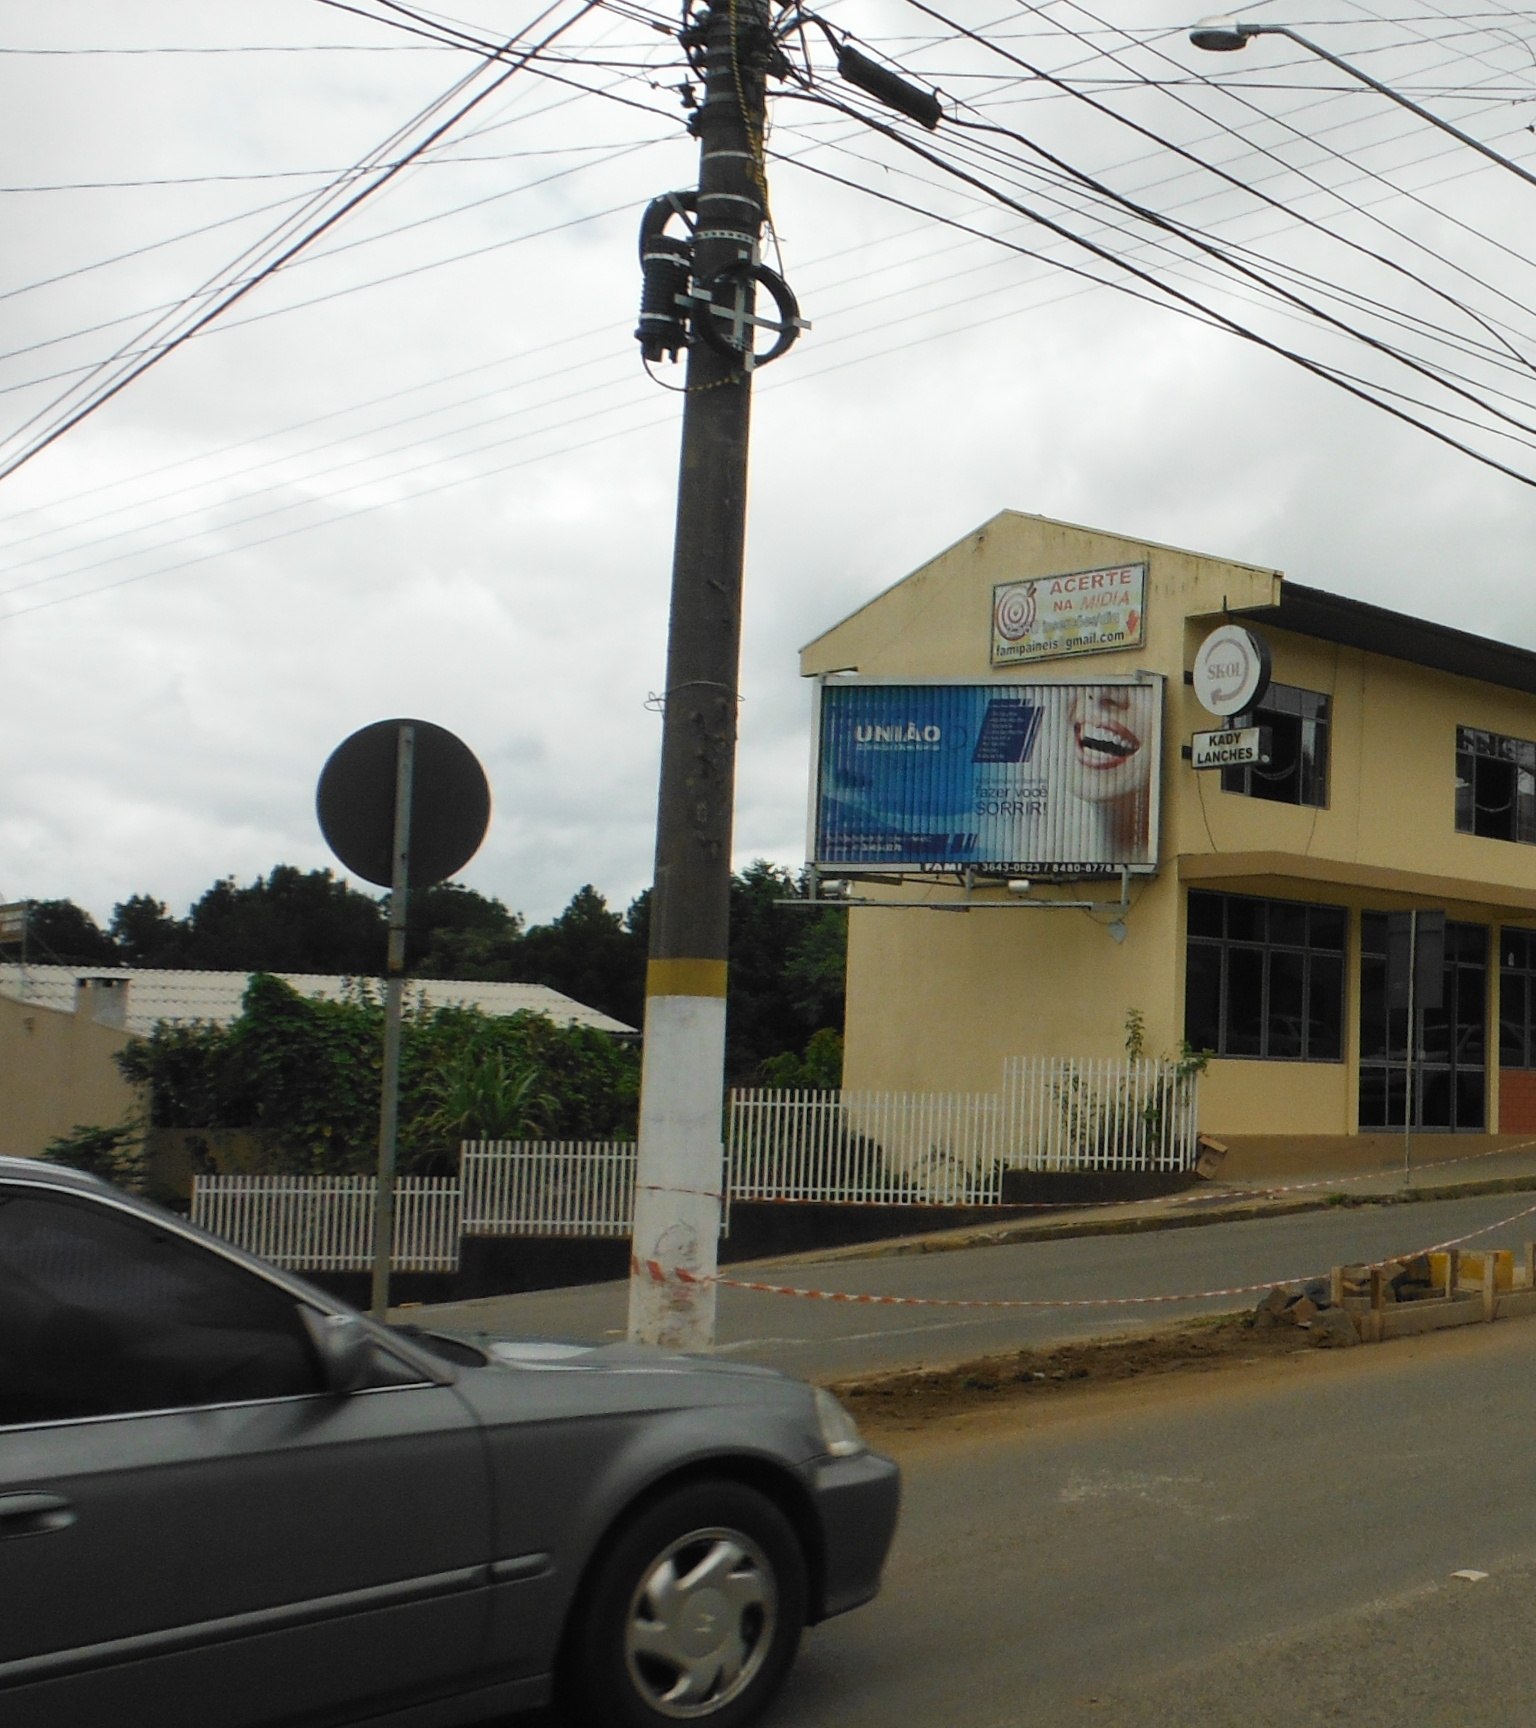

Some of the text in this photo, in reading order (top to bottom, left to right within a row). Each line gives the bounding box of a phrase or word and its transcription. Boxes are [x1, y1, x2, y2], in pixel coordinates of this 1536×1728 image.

[1049, 569, 1132, 595] ACERTE
[1053, 599, 1073, 612] NA
[1207, 662, 1242, 681] SKOL
[856, 721, 941, 742] UNIÃO
[1209, 732, 1242, 747] KADY
[1197, 747, 1253, 764] LANCHES
[975, 785, 1010, 798] fazer
[975, 801, 1048, 816] SORRIR!
[925, 862, 963, 872] FAMI
